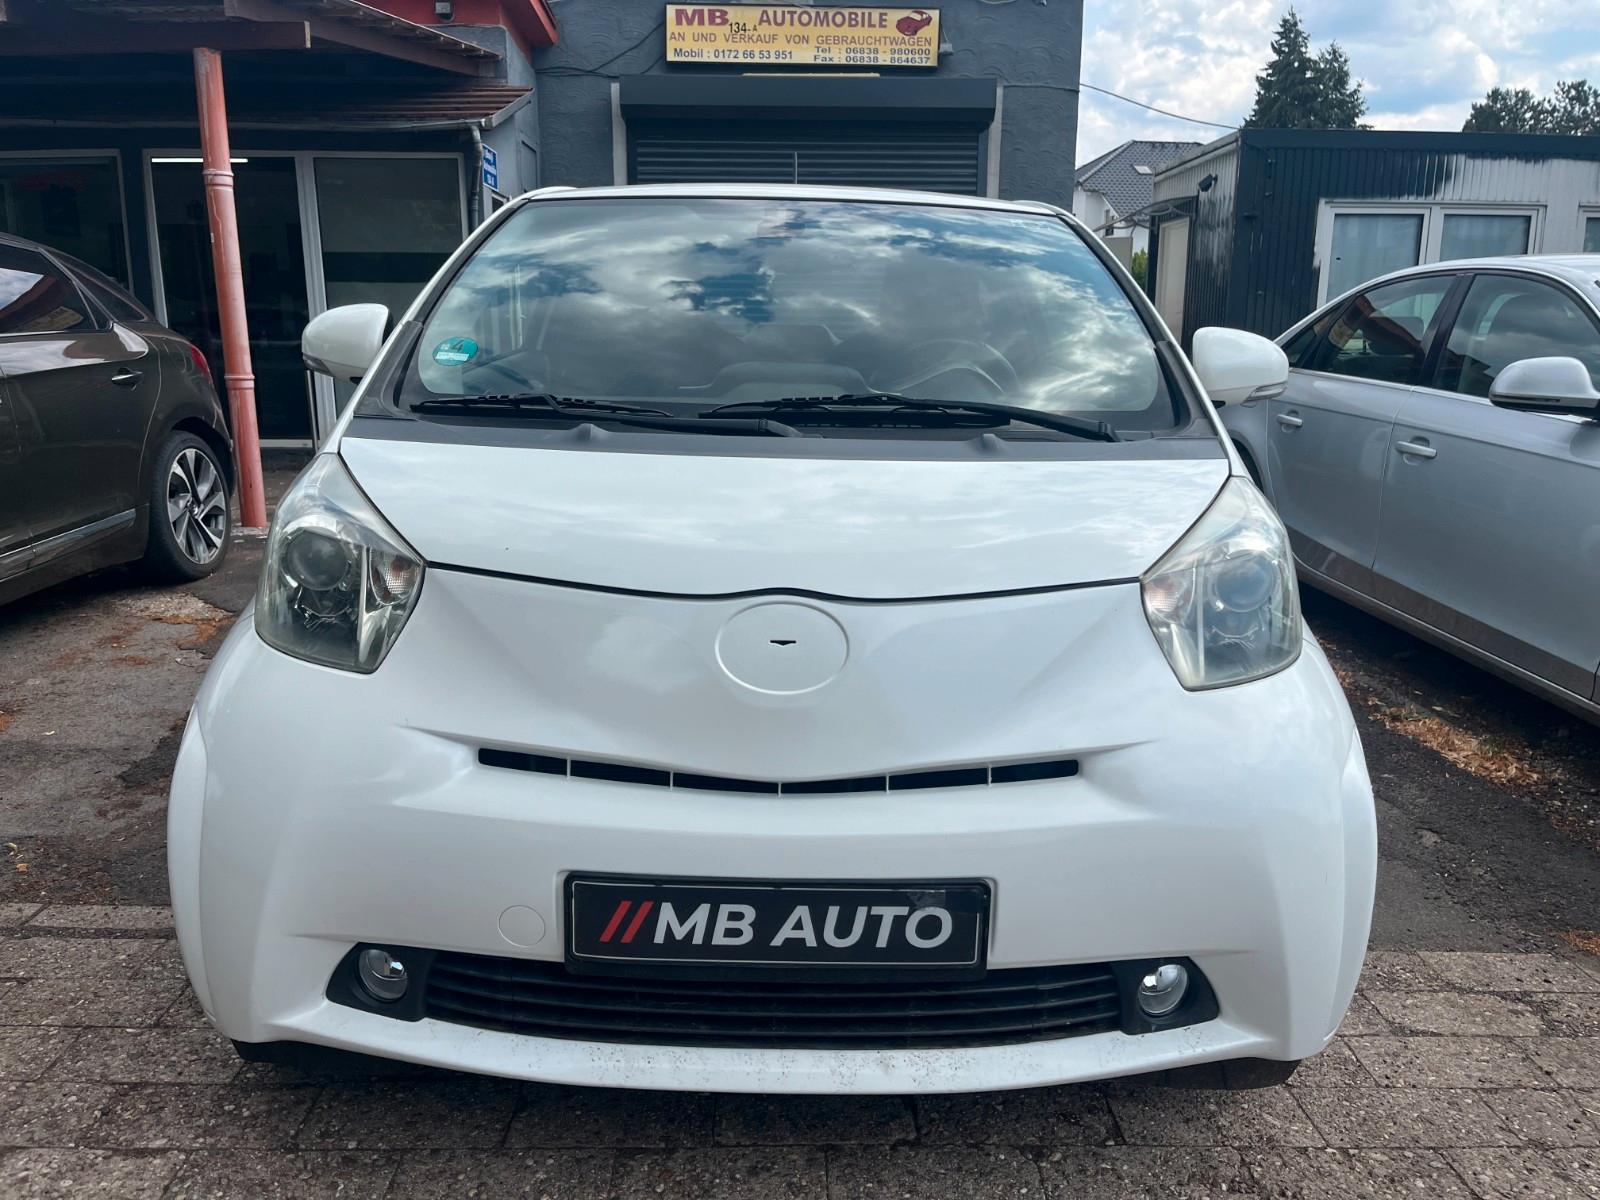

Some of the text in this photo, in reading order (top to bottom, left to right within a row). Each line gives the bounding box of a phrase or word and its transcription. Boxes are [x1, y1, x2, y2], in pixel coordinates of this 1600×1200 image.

[675, 8, 888, 28] MB AUTOMOBILE
[669, 32, 932, 46] AN UND VERKAUF VON GEBRAUCHTWAGEN
[713, 49, 739, 59] 0172
[742, 50, 755, 59] 66
[759, 50, 771, 60] 53
[774, 50, 793, 60] 951
[845, 47, 879, 55] 06838
[813, 55, 834, 63] Fax
[845, 55, 879, 63] 06838
[769, 904, 953, 949] AUTO
